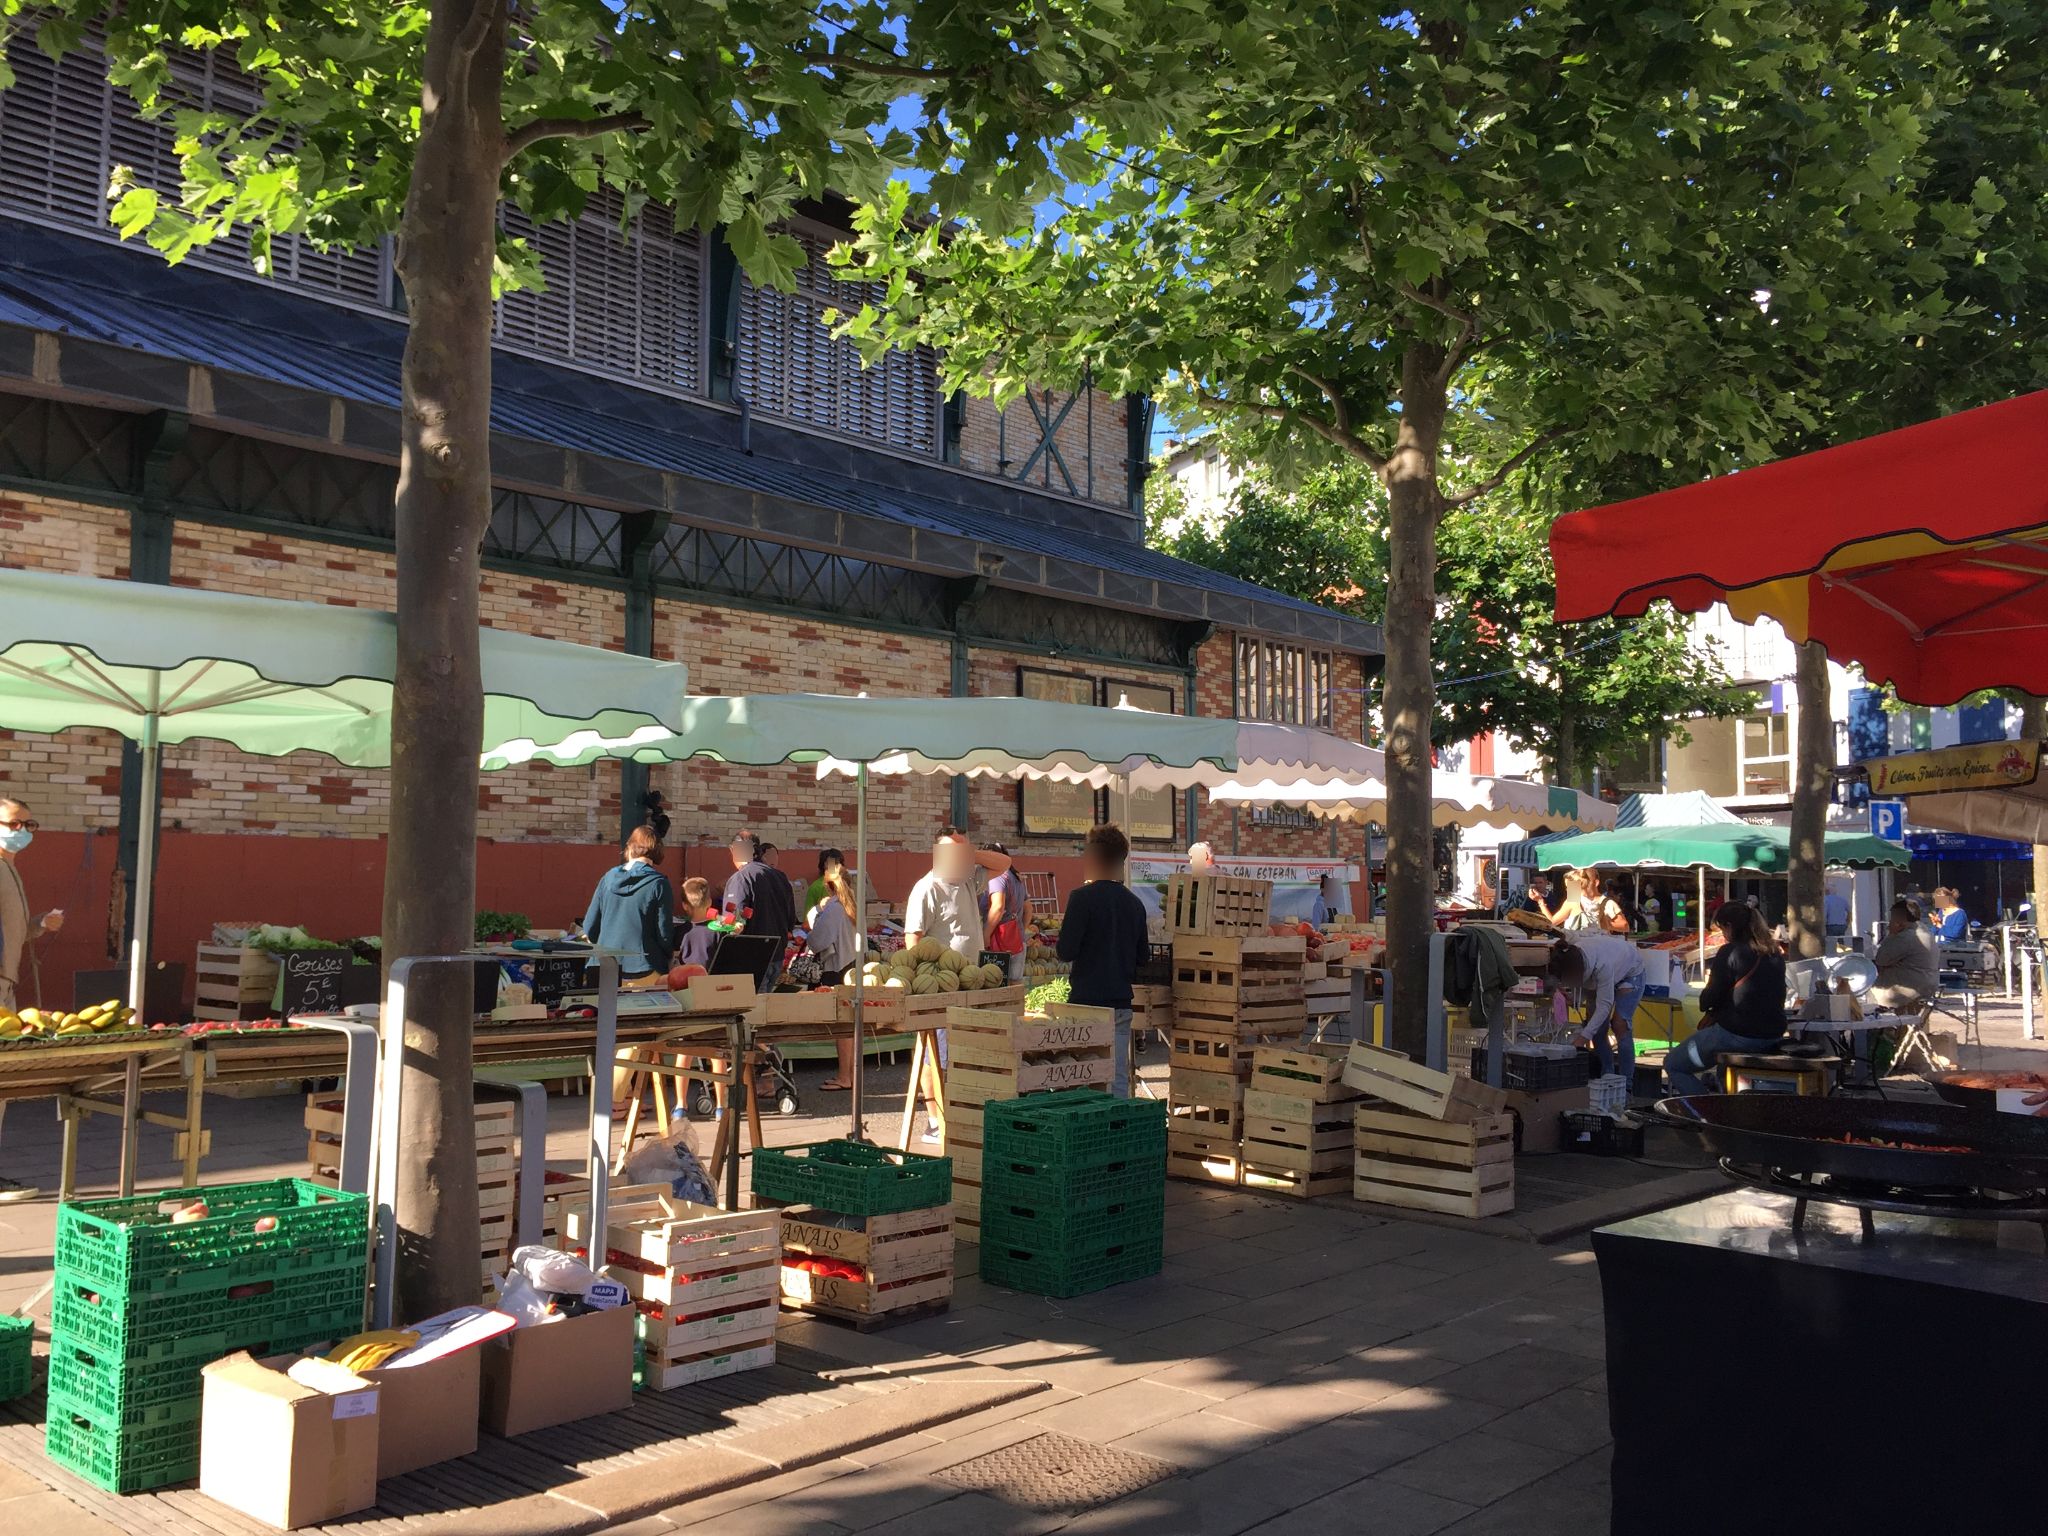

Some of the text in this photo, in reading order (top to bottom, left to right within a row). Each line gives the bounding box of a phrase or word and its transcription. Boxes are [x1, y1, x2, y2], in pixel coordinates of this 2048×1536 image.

[1879, 809, 1894, 834] P
[1256, 867, 1297, 880] ESTEBAN
[288, 953, 343, 972] Cerises
[1038, 1026, 1092, 1047] ANAIS
[1041, 1064, 1093, 1086] ANAIS
[780, 1223, 842, 1251] ANAIS
[595, 1287, 615, 1295] MAPA
